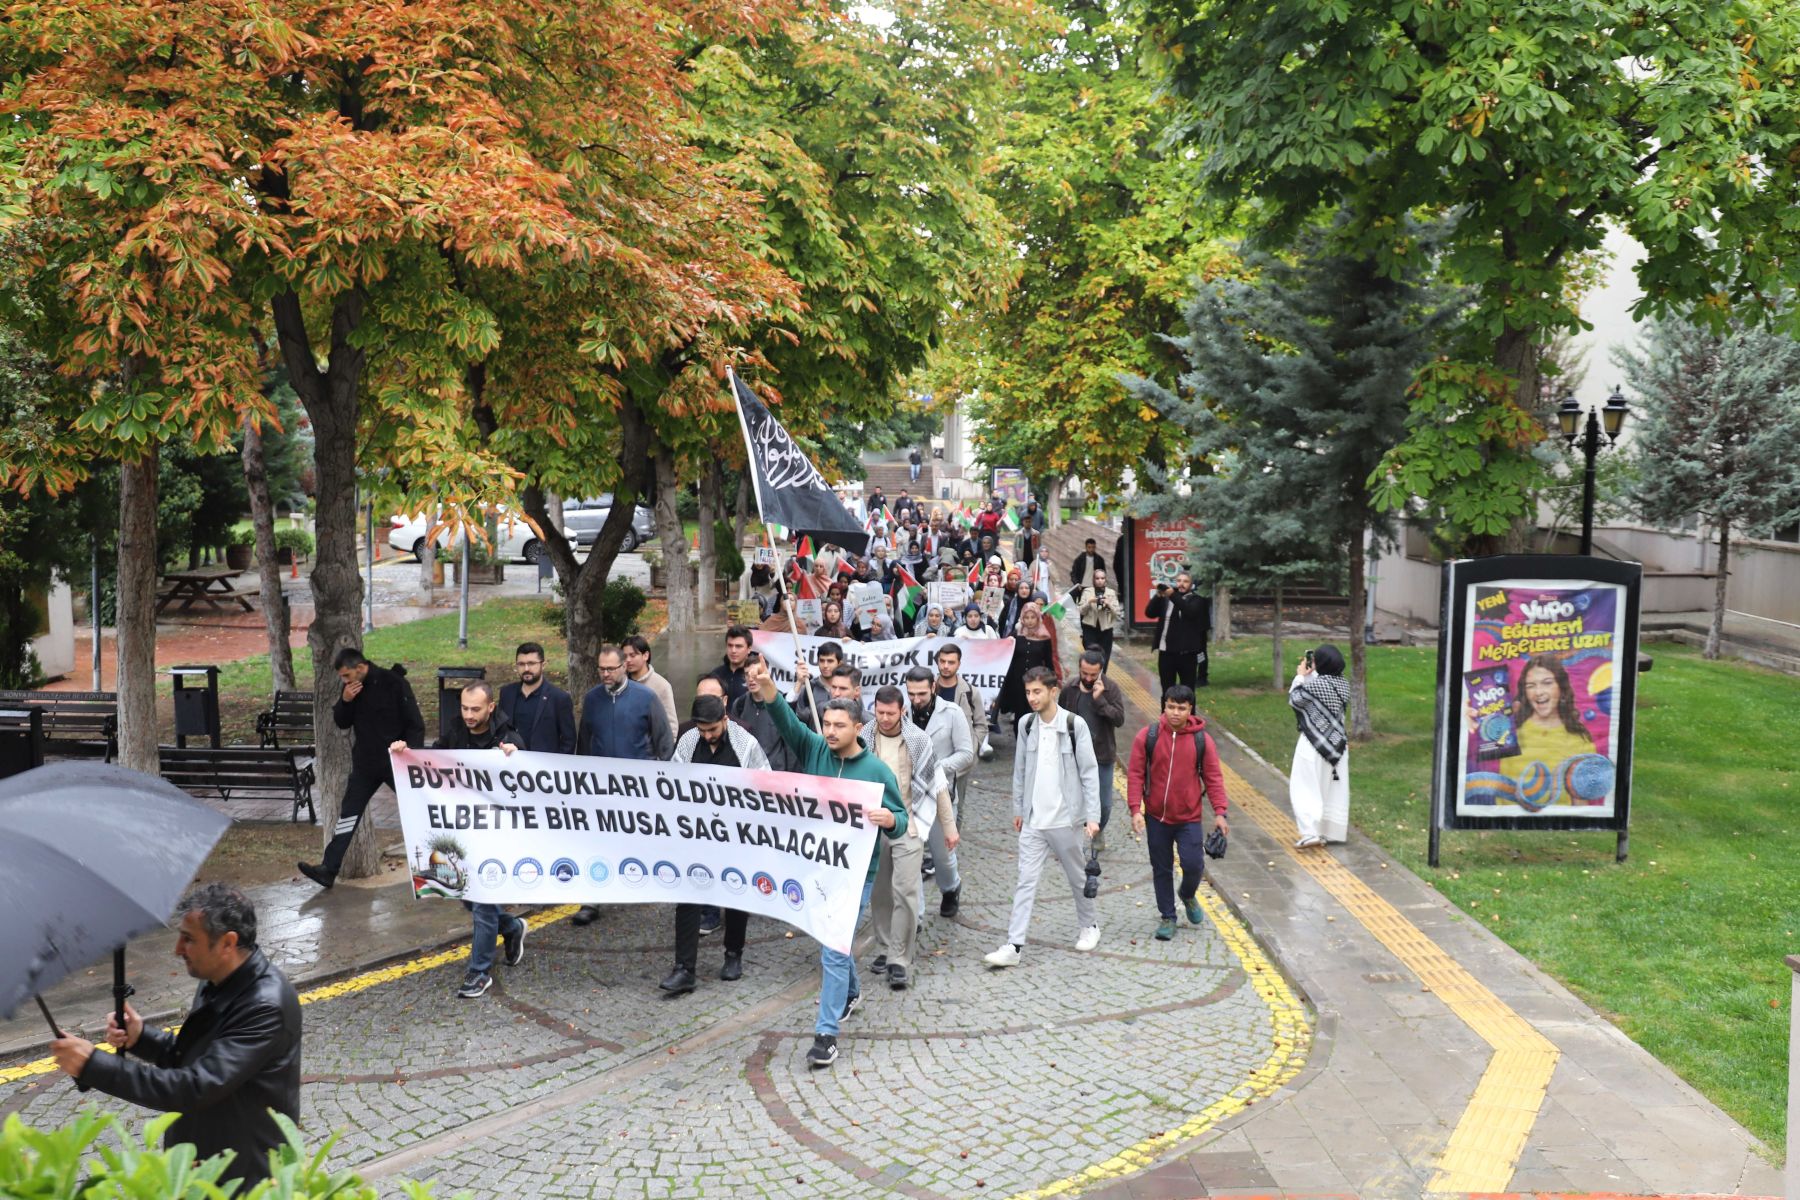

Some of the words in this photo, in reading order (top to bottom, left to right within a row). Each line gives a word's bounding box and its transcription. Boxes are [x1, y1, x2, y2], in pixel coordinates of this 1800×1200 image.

[1477, 591, 1506, 611] YENİ
[1502, 615, 1583, 640] EĞLENCEYİ
[1572, 632, 1612, 649] UZAT
[874, 650, 920, 669] YOK
[407, 762, 493, 792] BÜTÜN
[499, 770, 650, 799] ÇOCUKLARI
[656, 771, 823, 820] ÖLDÜRSENİZ
[828, 799, 864, 829] DE
[427, 804, 539, 830] ELBETTE
[545, 801, 590, 831] BİR
[595, 808, 671, 837] MUSA
[676, 812, 730, 843] SAĞ
[736, 821, 850, 869] KALACAK
